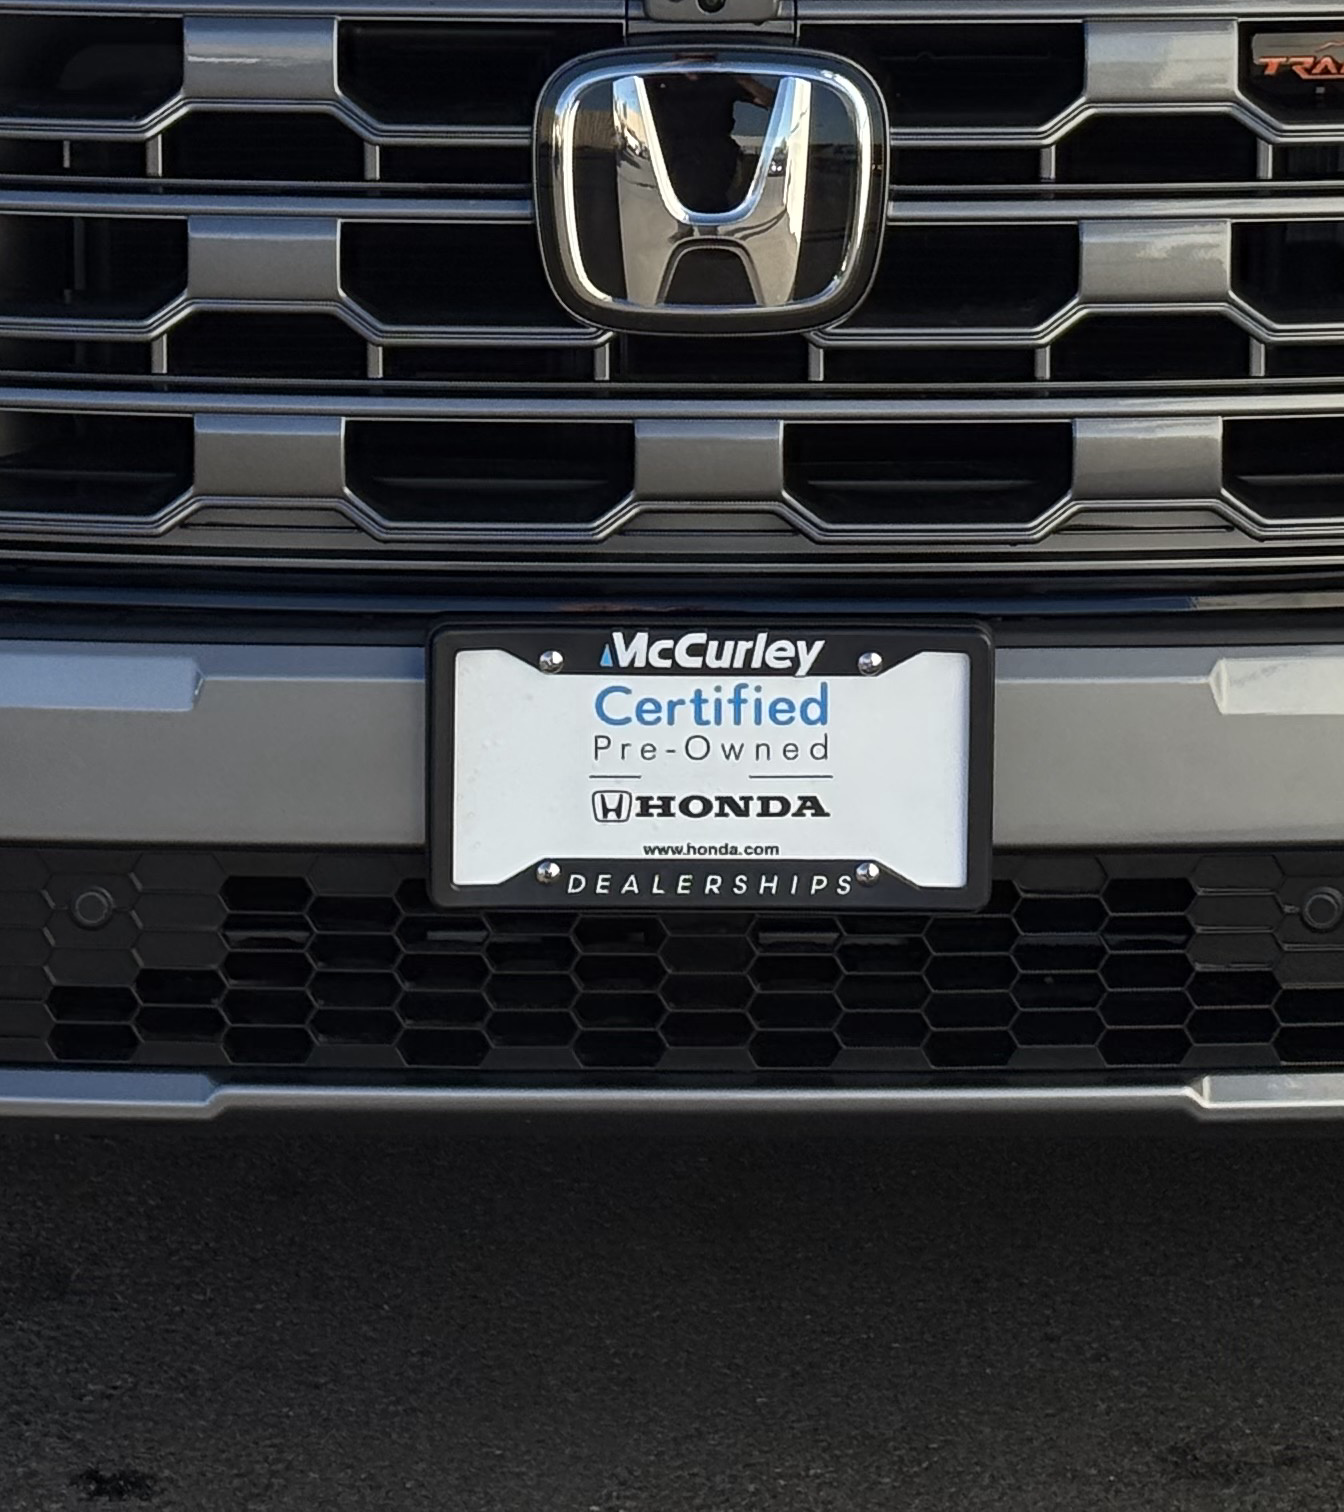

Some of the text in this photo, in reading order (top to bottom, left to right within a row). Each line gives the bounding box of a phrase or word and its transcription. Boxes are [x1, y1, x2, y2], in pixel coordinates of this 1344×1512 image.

[600, 631, 826, 677] McCurley
[594, 682, 829, 727] Certified
[594, 734, 829, 761] Pre-Owned
[635, 795, 831, 818] HONDA
[643, 842, 780, 856] www.honda.com
[567, 874, 852, 895] DEALERSHIPS
